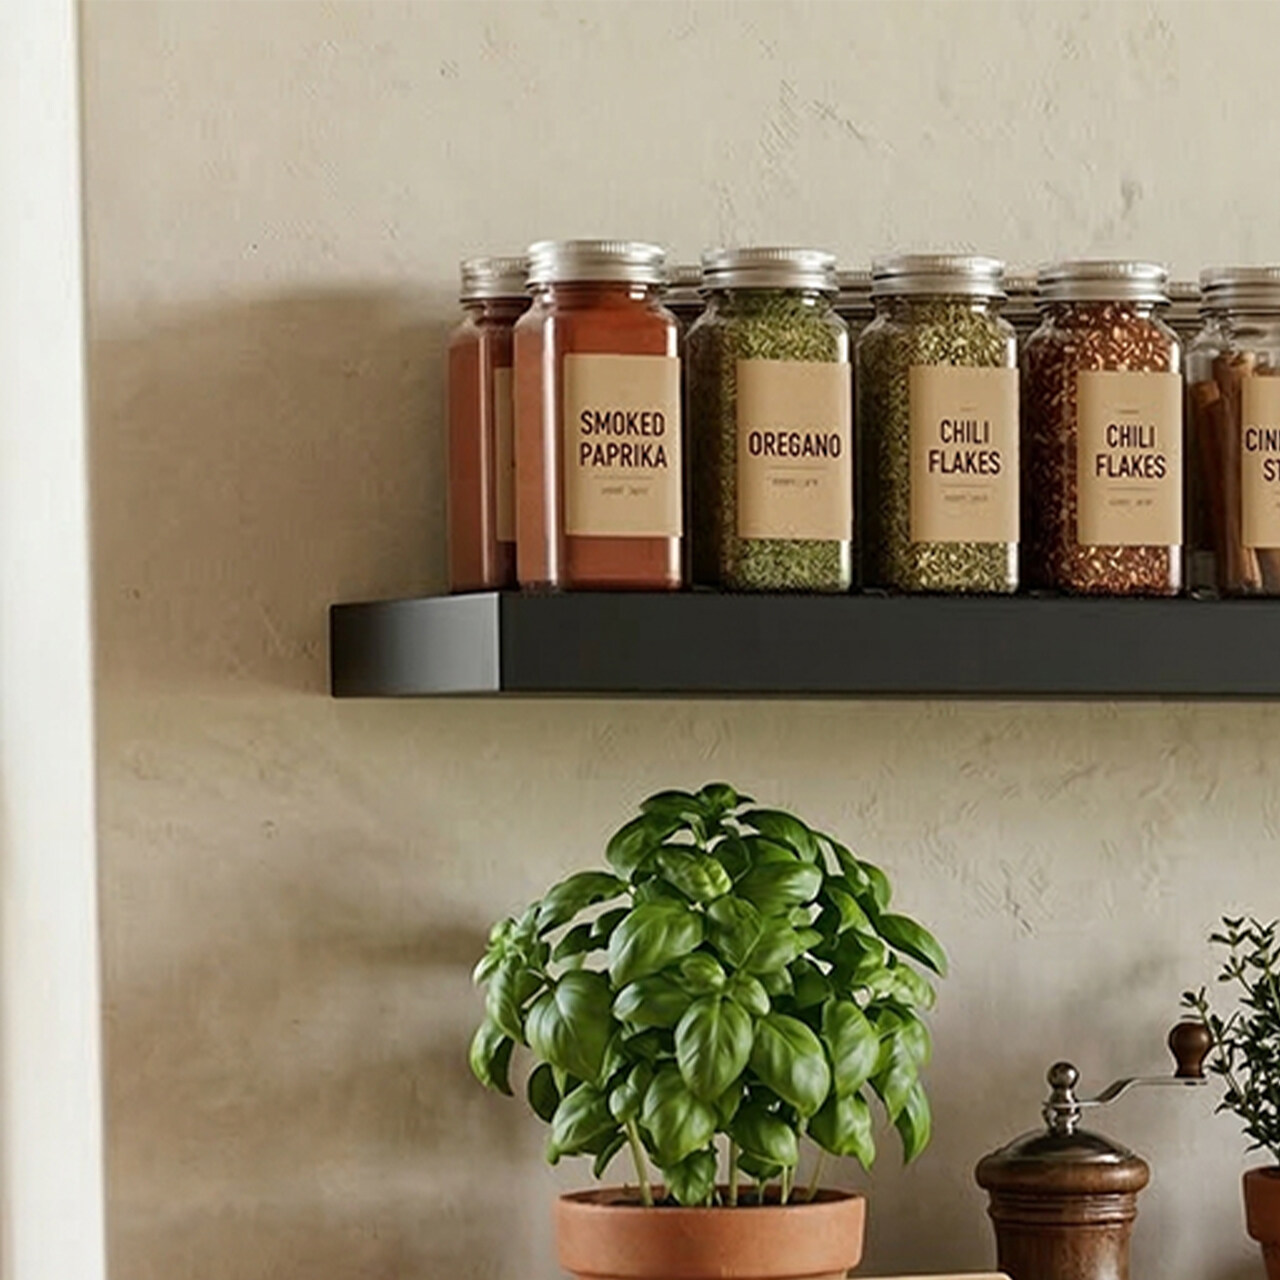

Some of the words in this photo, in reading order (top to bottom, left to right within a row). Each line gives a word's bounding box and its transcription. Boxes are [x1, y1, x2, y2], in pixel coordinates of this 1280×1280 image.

[580, 410, 665, 436] SMOKED
[940, 419, 990, 444] CHILI
[749, 431, 841, 458] OREGANO
[1106, 424, 1155, 449] CHILI
[580, 442, 668, 468] PAPRIKA
[928, 450, 1001, 474] FLAKES
[1096, 454, 1166, 478] FLAKES
